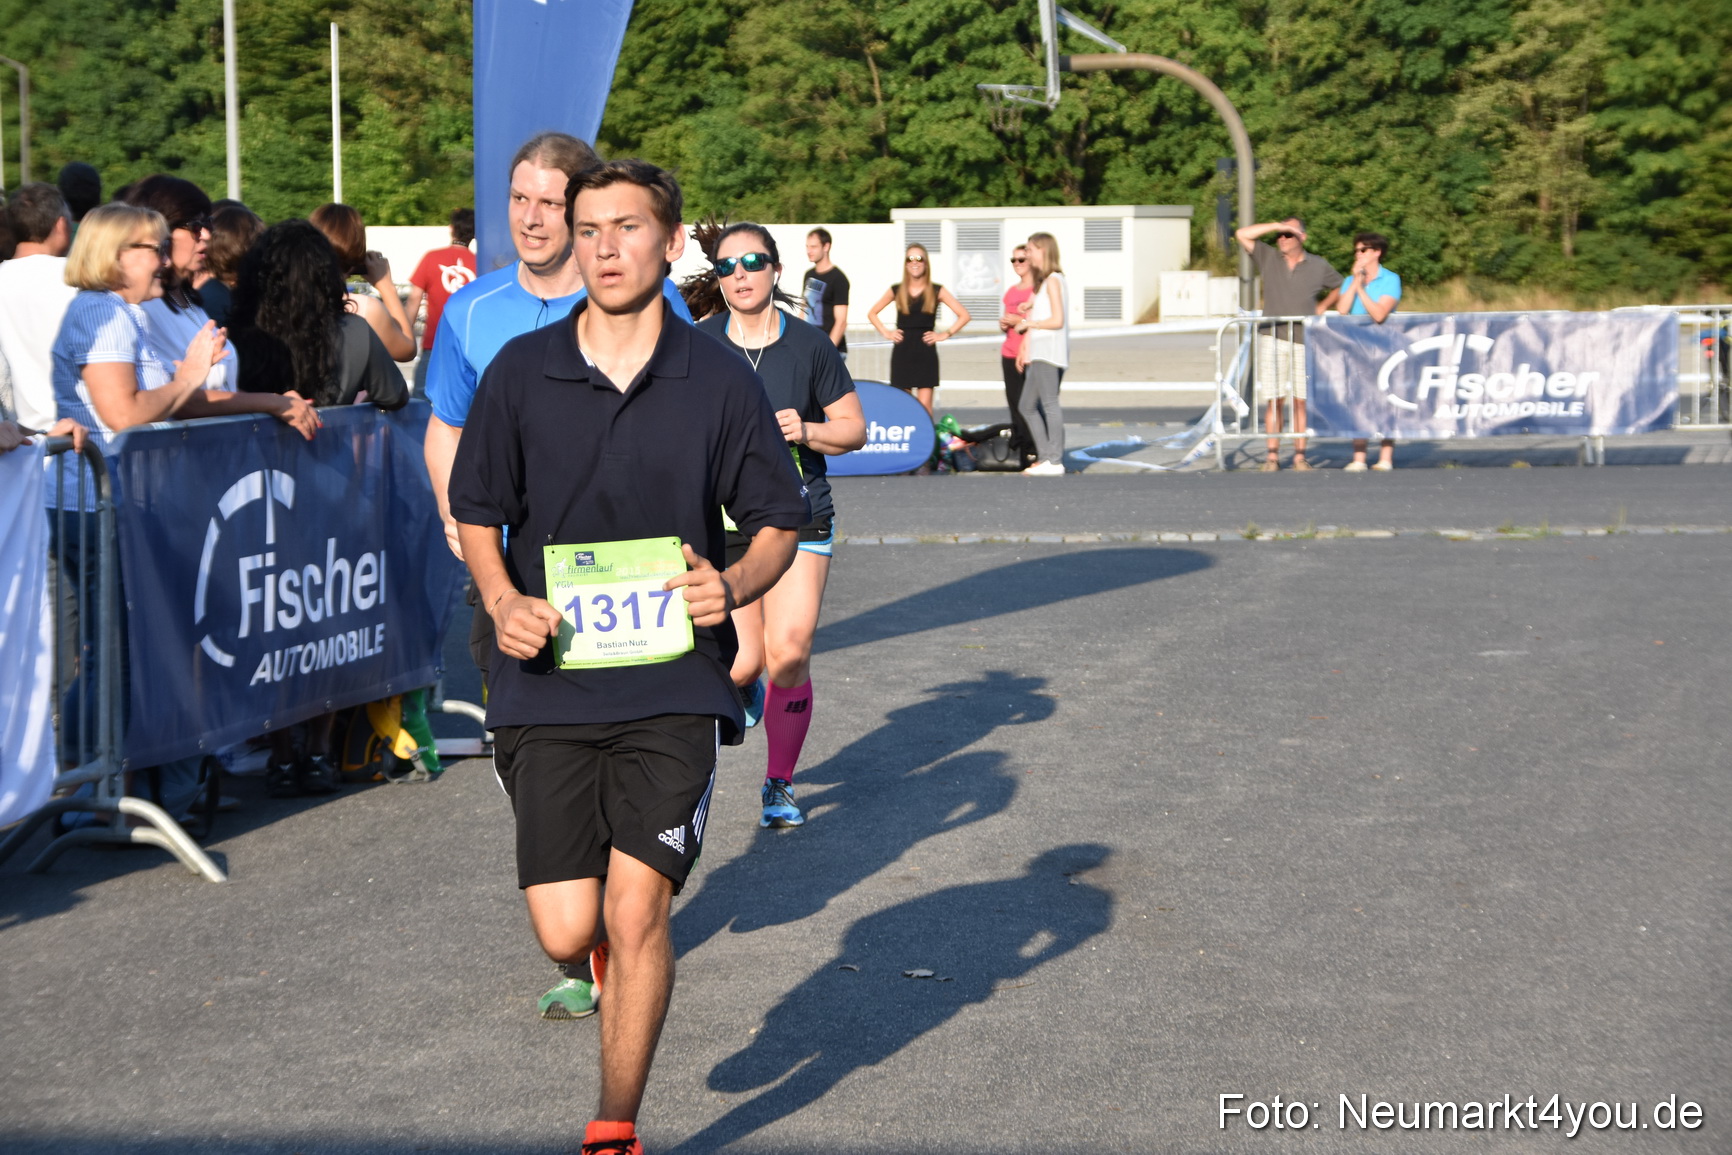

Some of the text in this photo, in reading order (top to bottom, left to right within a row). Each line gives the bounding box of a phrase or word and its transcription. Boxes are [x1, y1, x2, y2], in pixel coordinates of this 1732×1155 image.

[1416, 362, 1600, 401] Fischer
[1433, 401, 1585, 419] AUTOMOBILE
[567, 562, 614, 574] firmenlauf
[564, 590, 674, 634] 1317
[249, 622, 386, 687] AUTOMOBILE
[596, 639, 648, 650] Bastian Nutz
[657, 832, 686, 855] adidas
